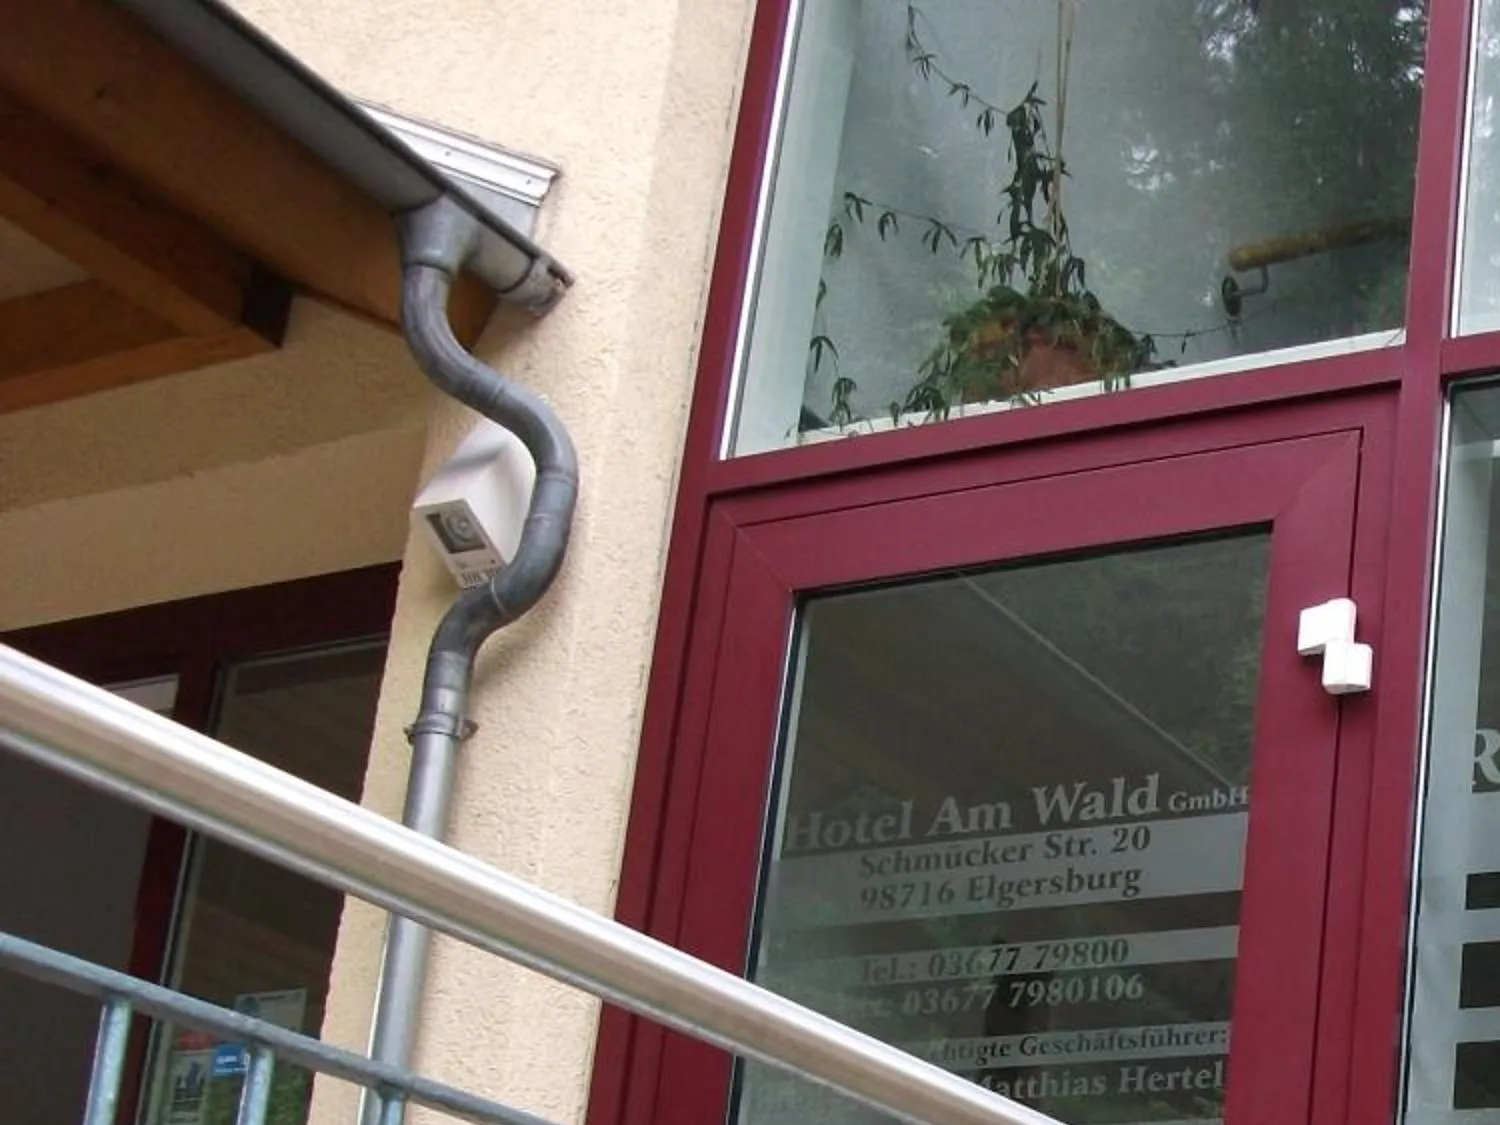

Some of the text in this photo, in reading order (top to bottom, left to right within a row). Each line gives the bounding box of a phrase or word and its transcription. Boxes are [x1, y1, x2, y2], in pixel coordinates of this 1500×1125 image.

[784, 773, 1250, 852] Hotel Am Wald GmbH
[858, 824, 1151, 878] Schmücker Str. 20
[859, 865, 1143, 913] 98716 Elgersburg
[927, 944, 1020, 977] 03677
[1032, 937, 1130, 971] 79800
[1009, 972, 1144, 1008] 7980106
[1118, 1062, 1224, 1093] Hertel
